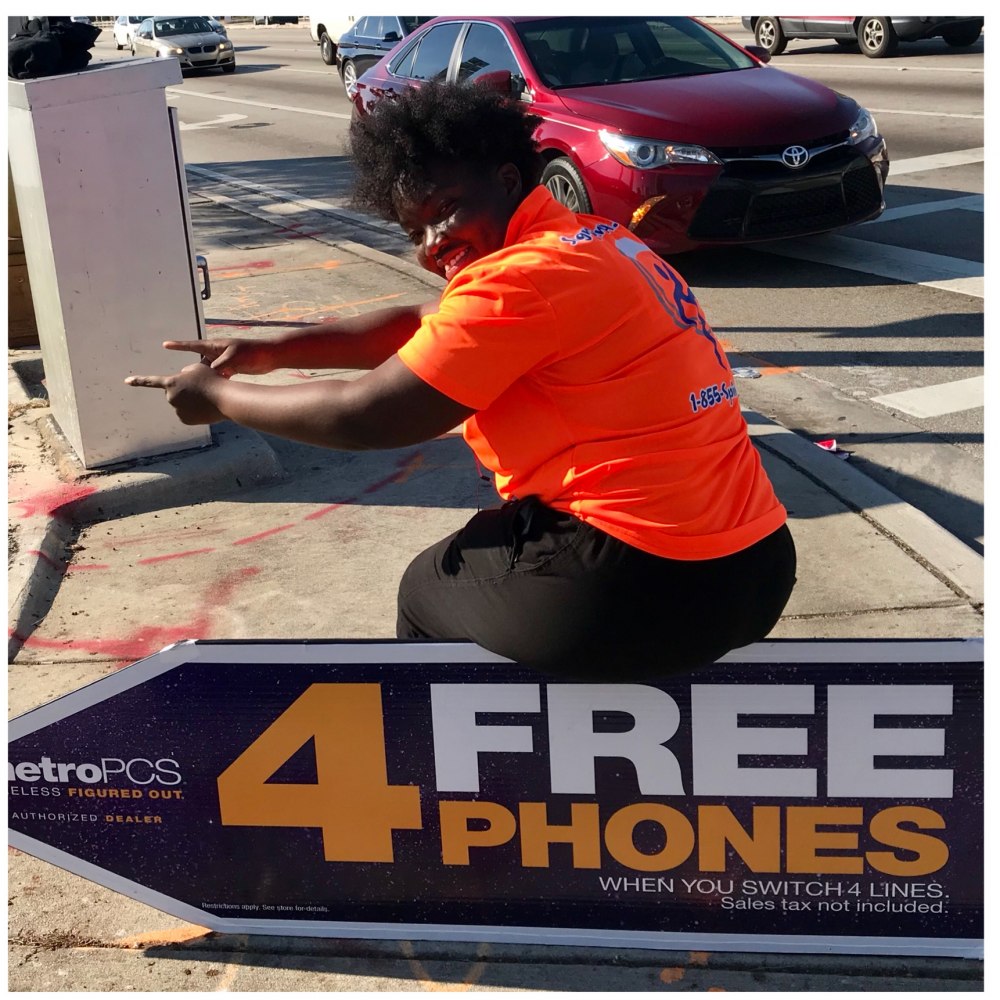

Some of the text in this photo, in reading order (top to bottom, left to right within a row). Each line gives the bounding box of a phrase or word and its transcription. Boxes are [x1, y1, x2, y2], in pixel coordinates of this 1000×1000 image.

[217, 683, 955, 863] 4 FREE
[9, 786, 185, 800] ELESS FIGURED OUT.
[11, 811, 162, 824] AUTHORIZED DEALER
[439, 801, 949, 877] PHONES
[599, 876, 950, 899] WHEN YOU SWITCH 4 LINES.
[202, 902, 241, 910] Restrictions
[721, 896, 950, 914] Sales tax not included.
